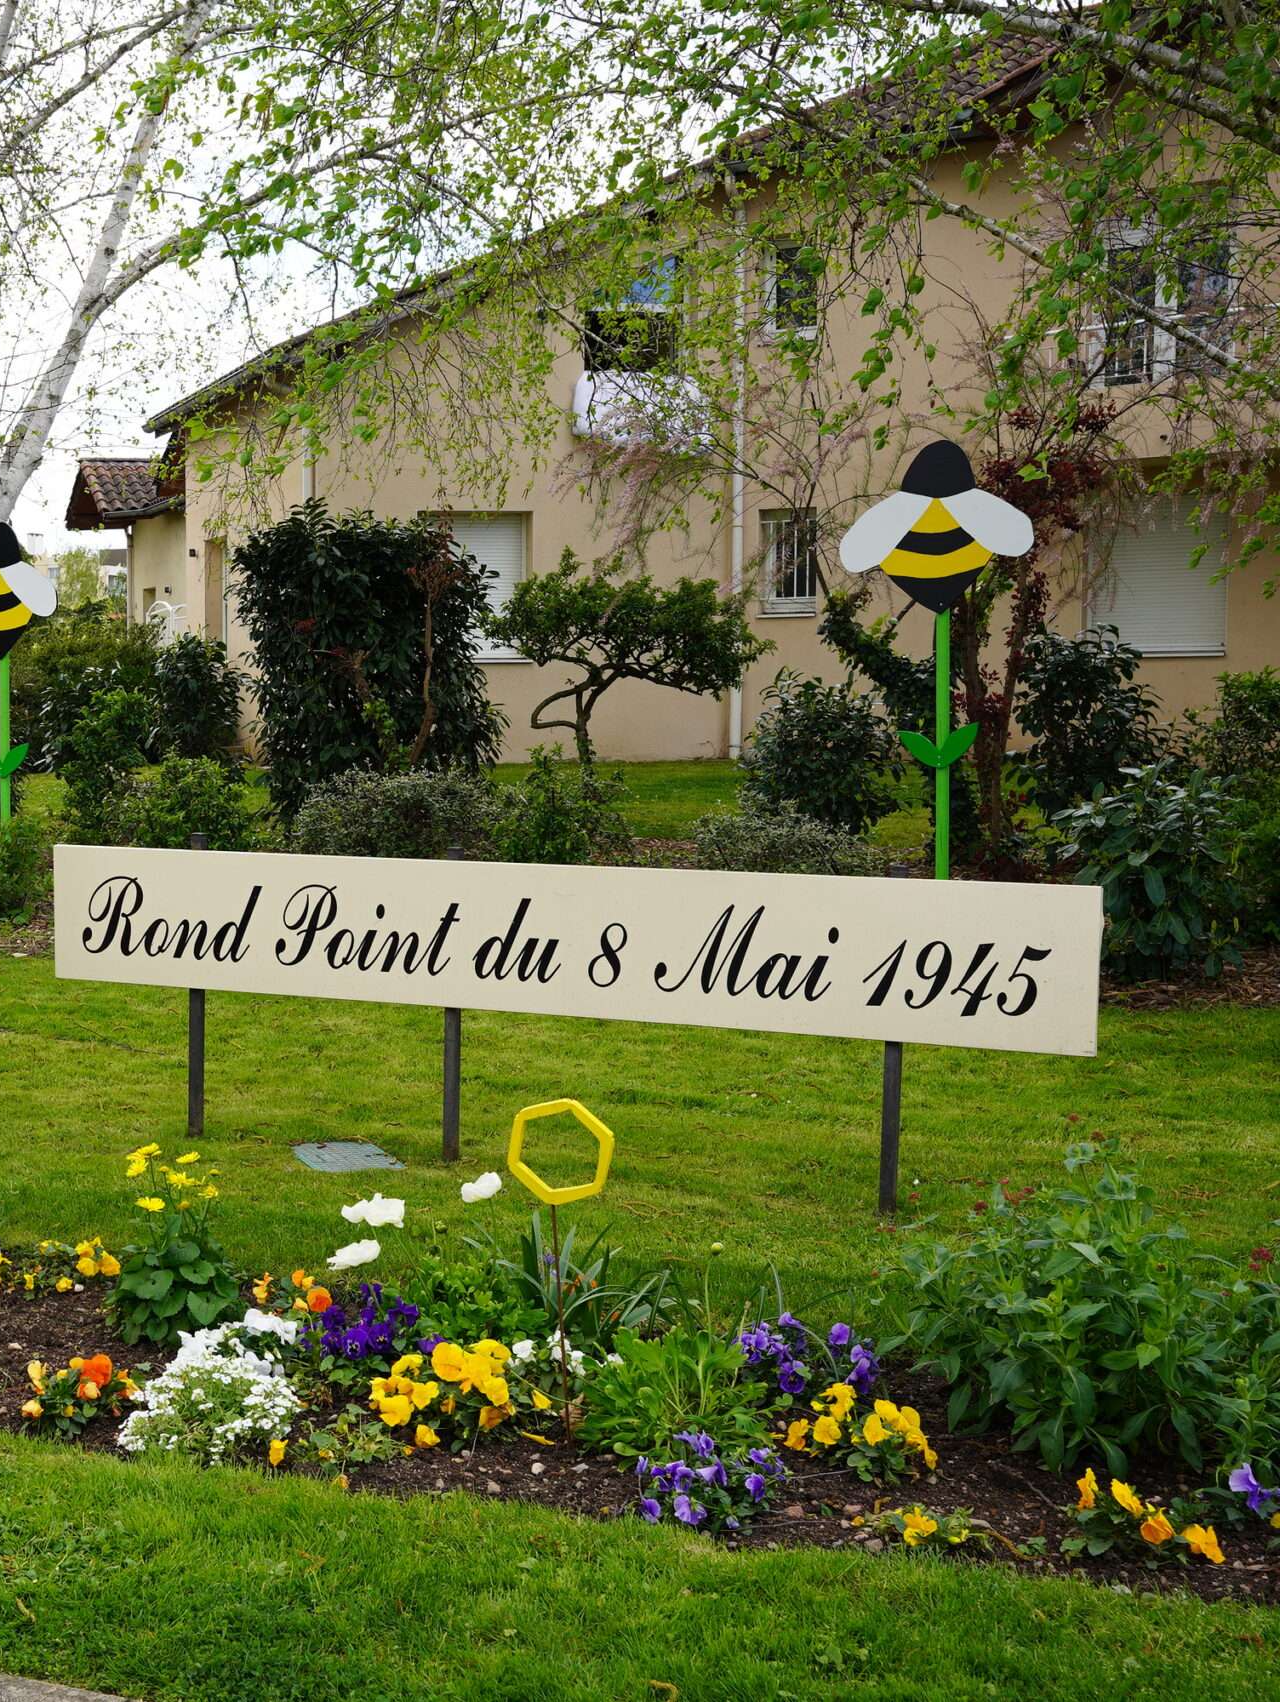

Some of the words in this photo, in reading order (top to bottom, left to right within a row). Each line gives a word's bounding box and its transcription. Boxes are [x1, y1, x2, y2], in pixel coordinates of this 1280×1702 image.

[83, 876, 263, 962] Rond
[276, 885, 461, 976] Point
[473, 898, 561, 983] du
[588, 923, 627, 987] 8
[654, 904, 839, 1001] Mai
[863, 940, 1052, 1017] 1945
